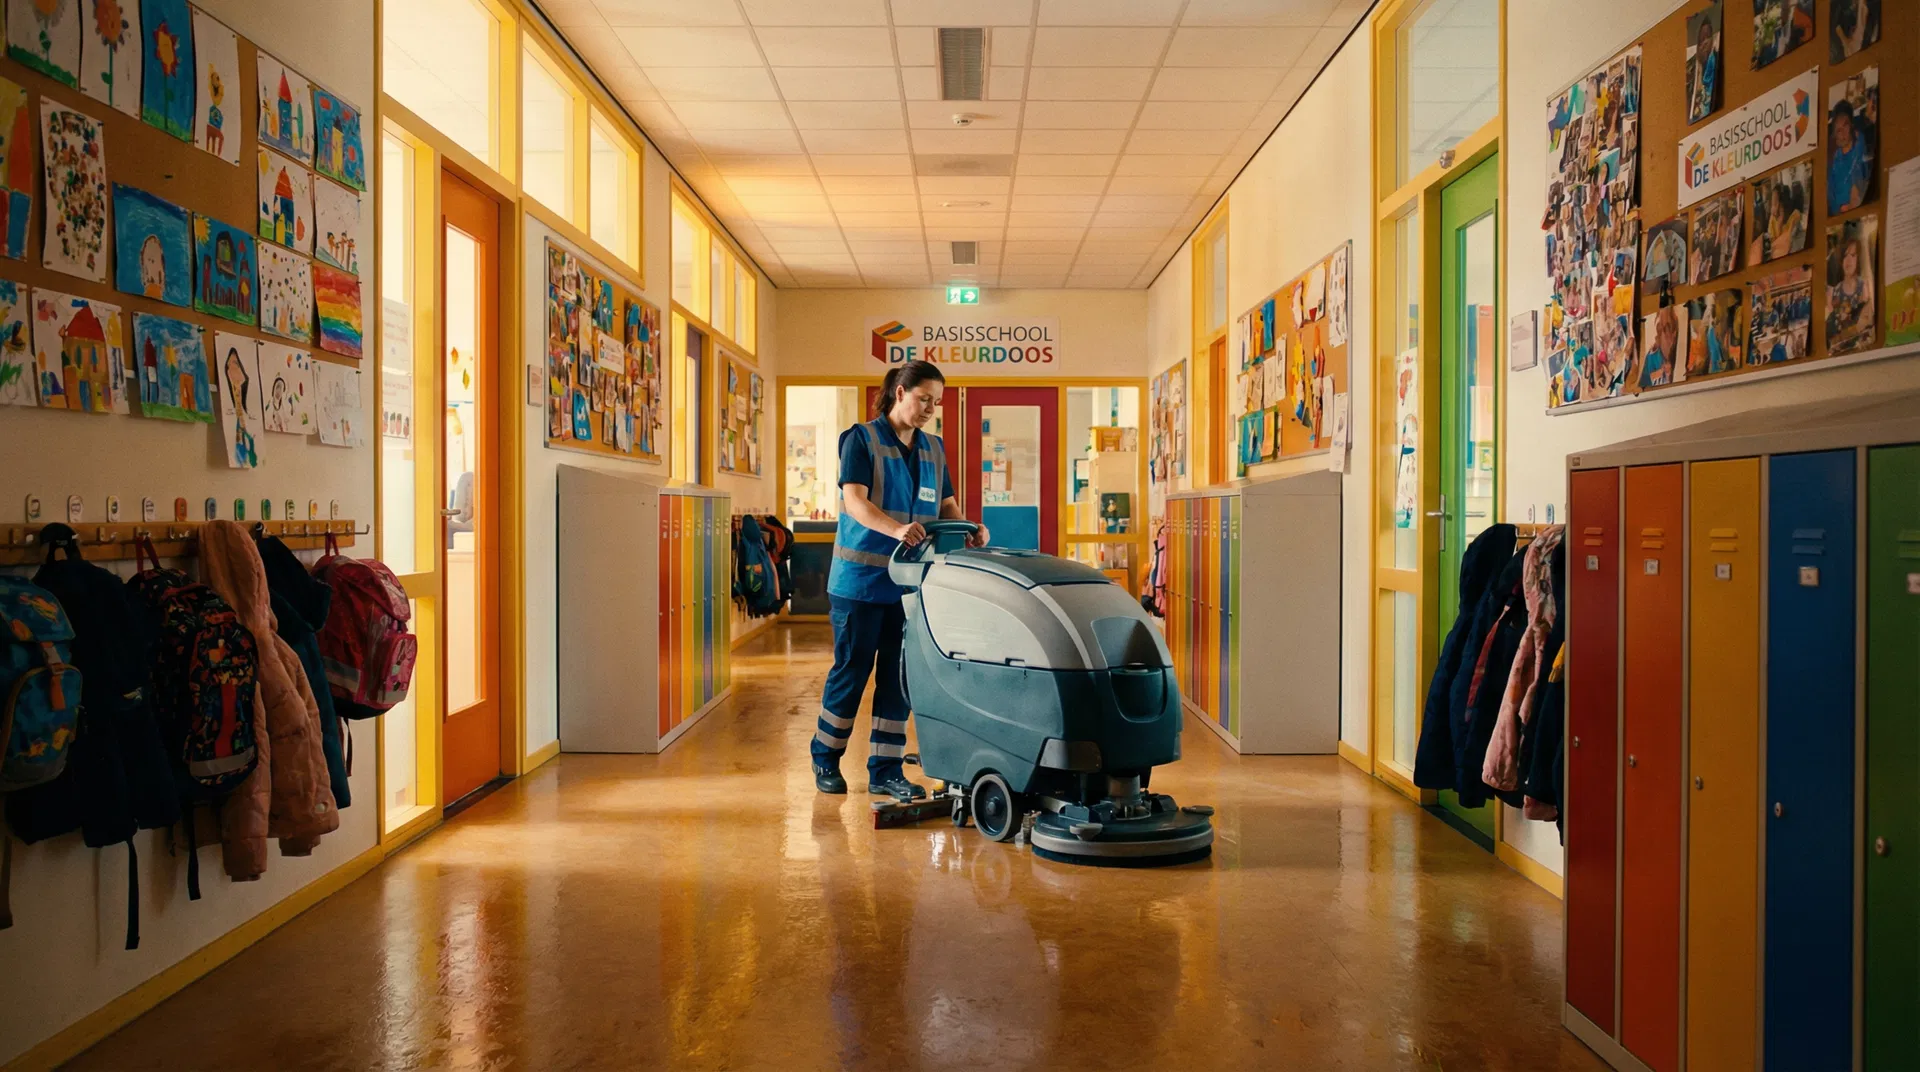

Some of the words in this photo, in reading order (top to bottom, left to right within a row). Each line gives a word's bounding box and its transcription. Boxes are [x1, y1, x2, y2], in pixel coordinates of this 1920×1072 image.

[1709, 100, 1791, 156] BASISSCHOOL
[1694, 163, 1709, 188] DE
[1712, 124, 1792, 179] KLEURDOOS
[923, 326, 1053, 342] BASISSCHOOL
[890, 346, 917, 363] DE
[924, 346, 1053, 363] KLEURDOOS
